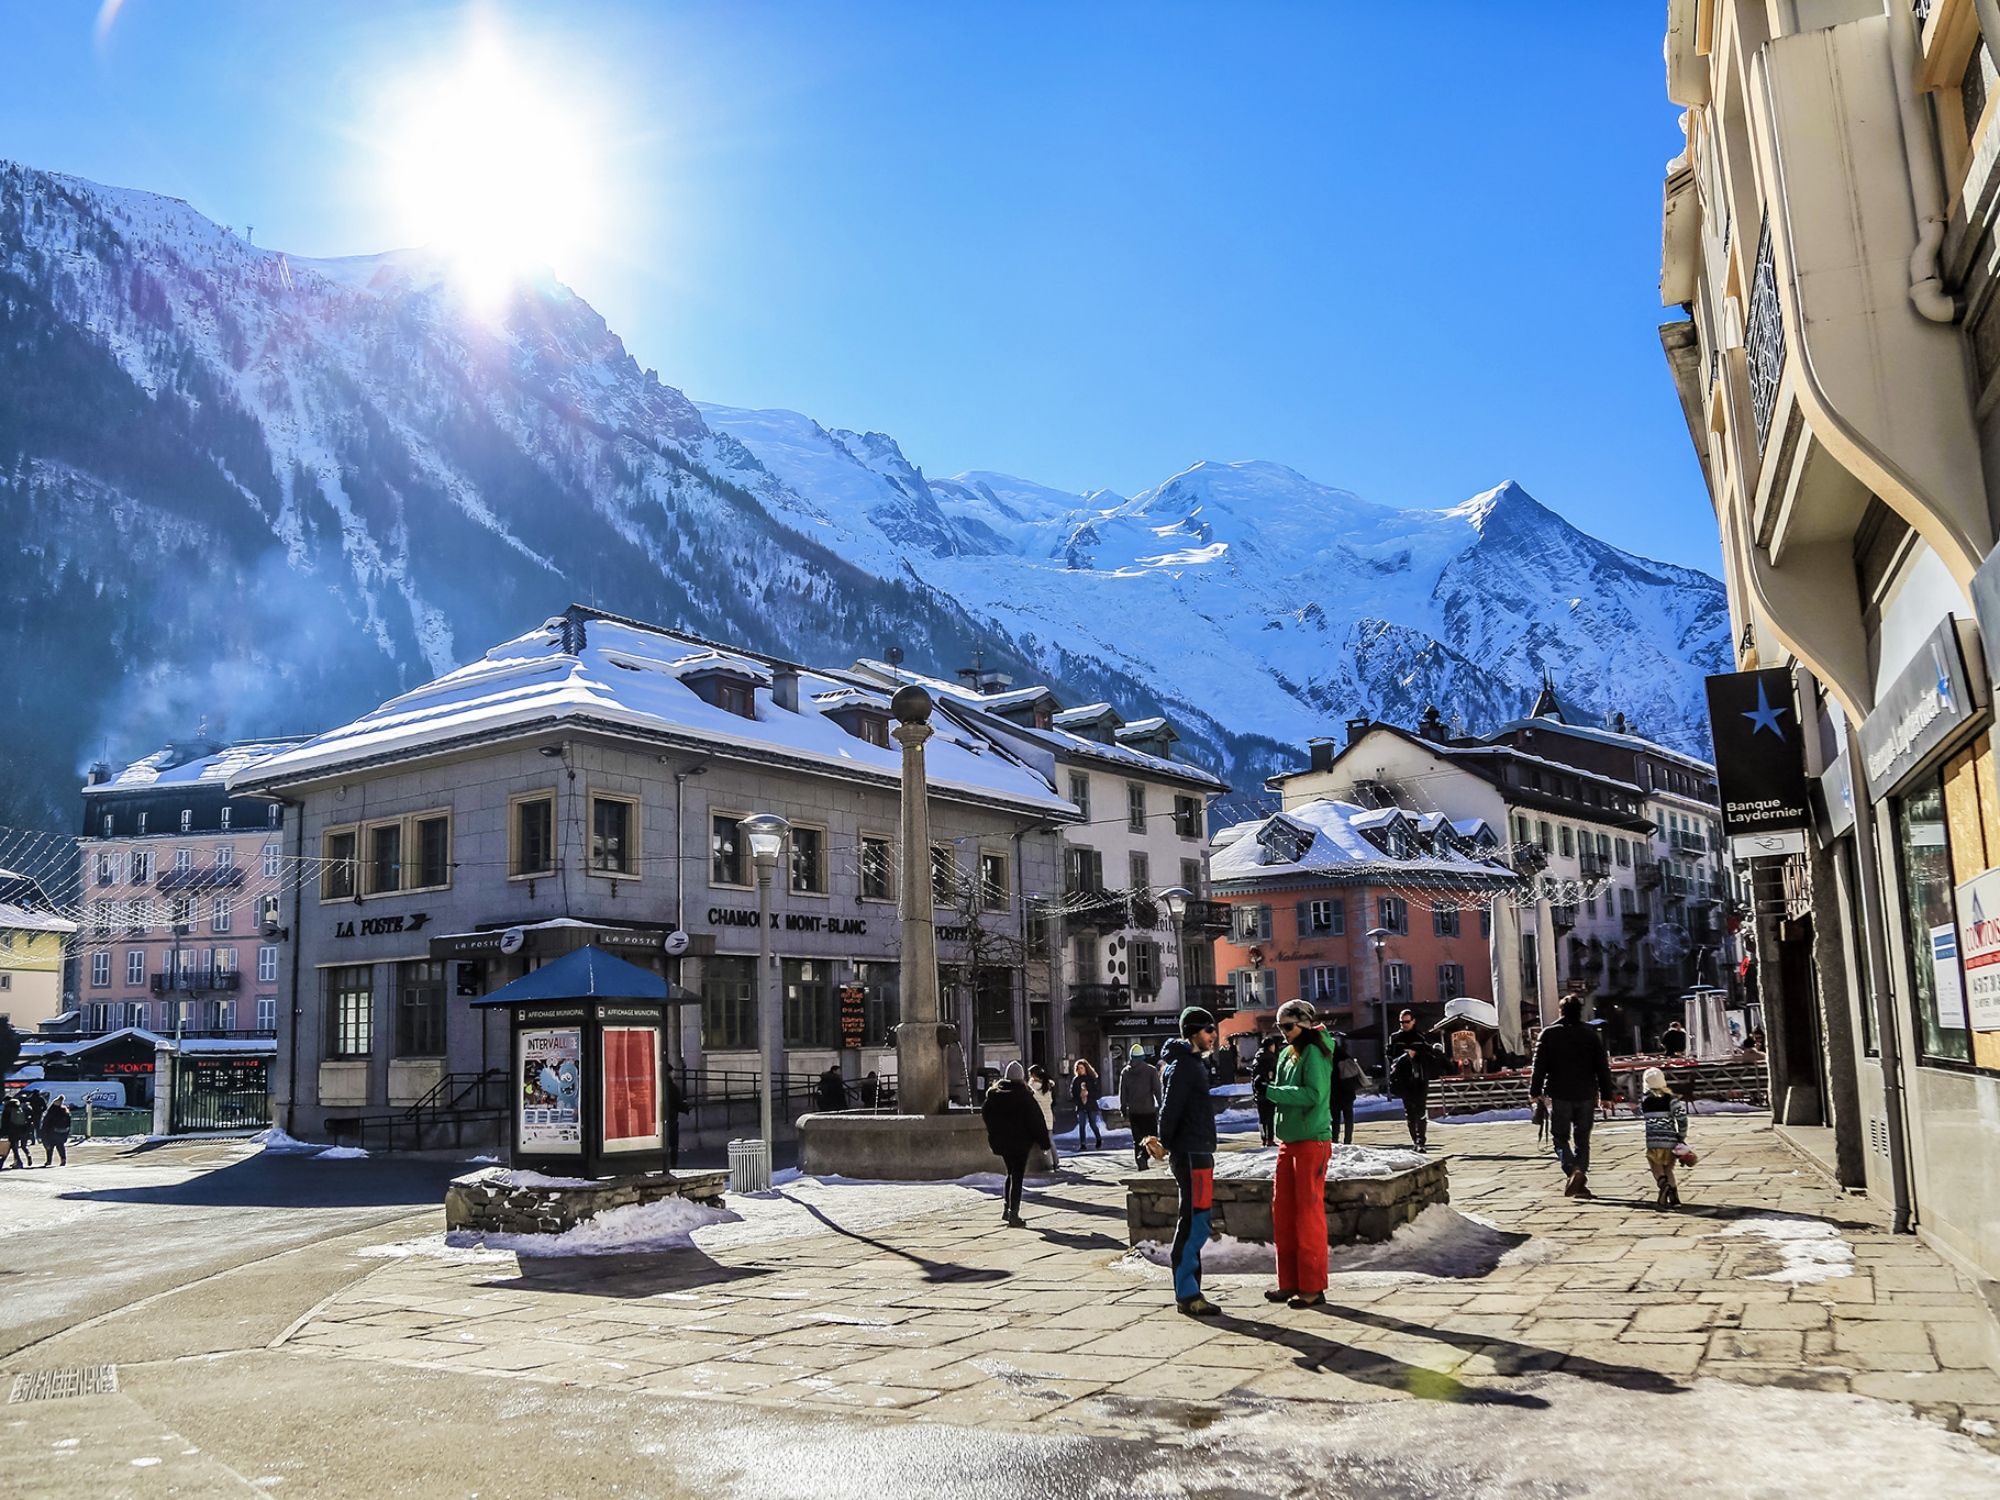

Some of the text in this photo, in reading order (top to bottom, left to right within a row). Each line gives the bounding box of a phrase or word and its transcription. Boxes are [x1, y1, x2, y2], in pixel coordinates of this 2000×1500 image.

[1726, 799, 1781, 812] Banque
[1727, 807, 1804, 823] Laydernier
[335, 916, 404, 938] LA POSTE
[786, 913, 867, 936] MONT-BLANC
[624, 937, 657, 945] POSTE
[528, 1009, 555, 1018] AFFICHAGE
[607, 1009, 633, 1017] AFFICHAGE
